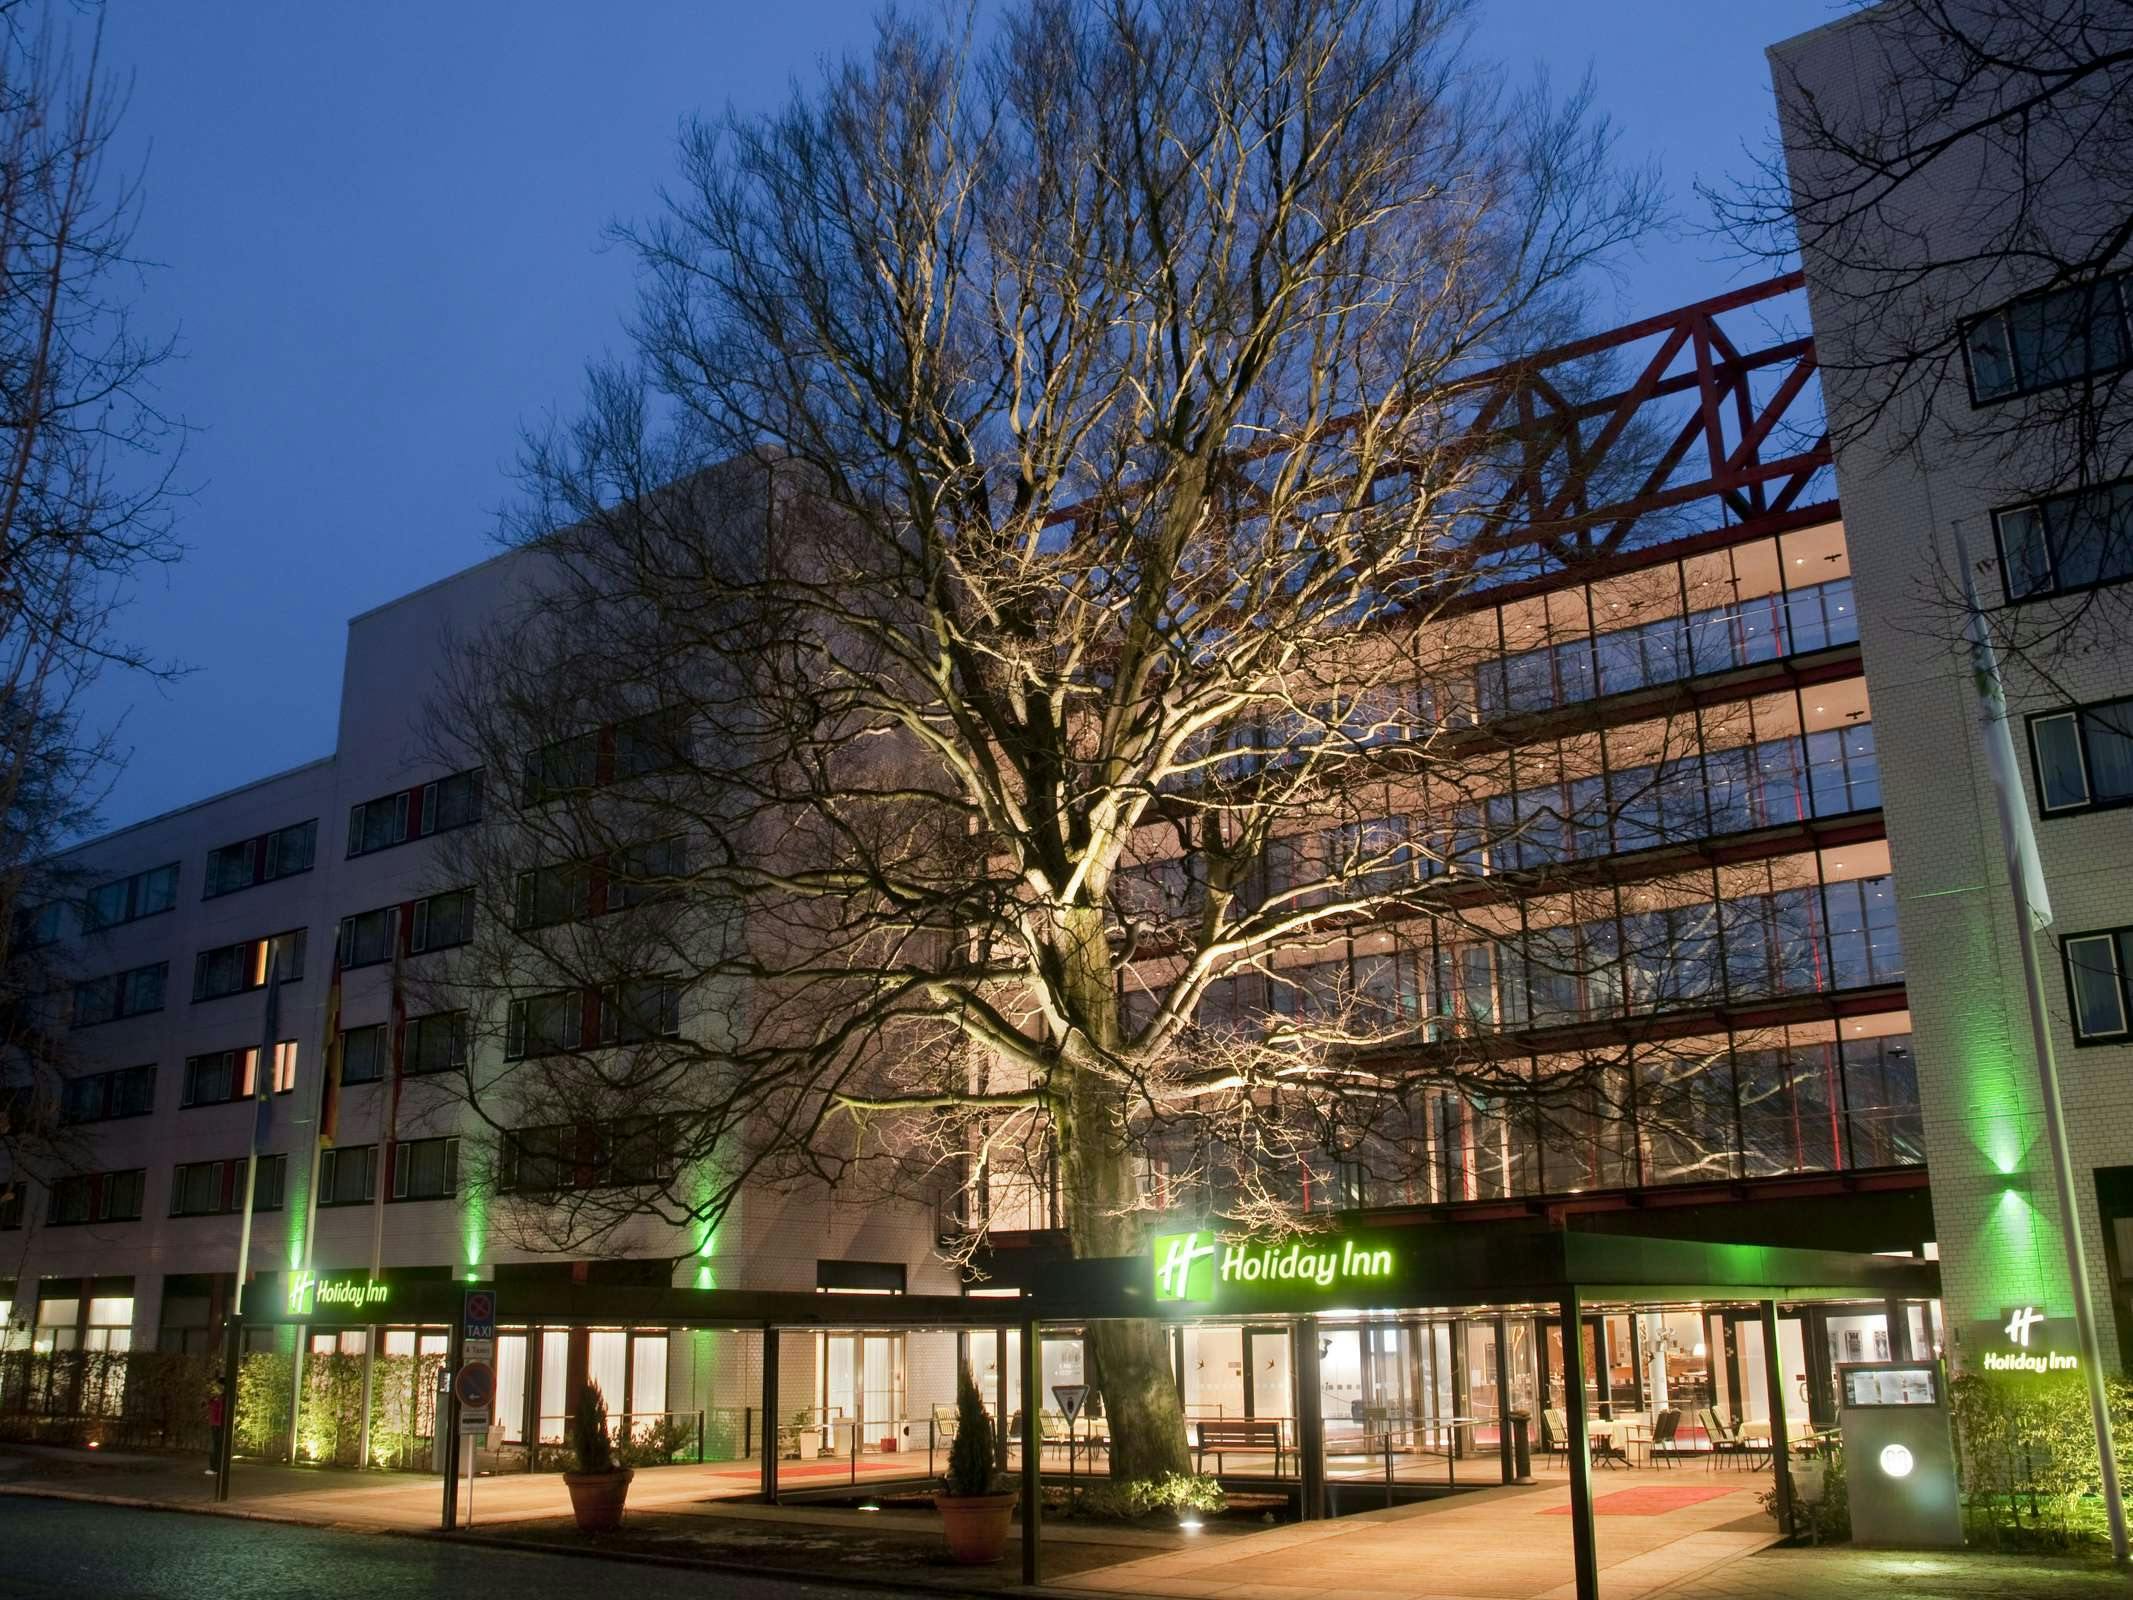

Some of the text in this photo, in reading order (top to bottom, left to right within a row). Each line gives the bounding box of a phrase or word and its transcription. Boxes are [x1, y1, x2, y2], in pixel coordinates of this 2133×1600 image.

[1221, 1240, 1392, 1286] Holiday Inn
[317, 1279, 388, 1308] Holiday Inn
[467, 1325, 492, 1337] TAXI
[1984, 1350, 2078, 1374] Holiday Inn
